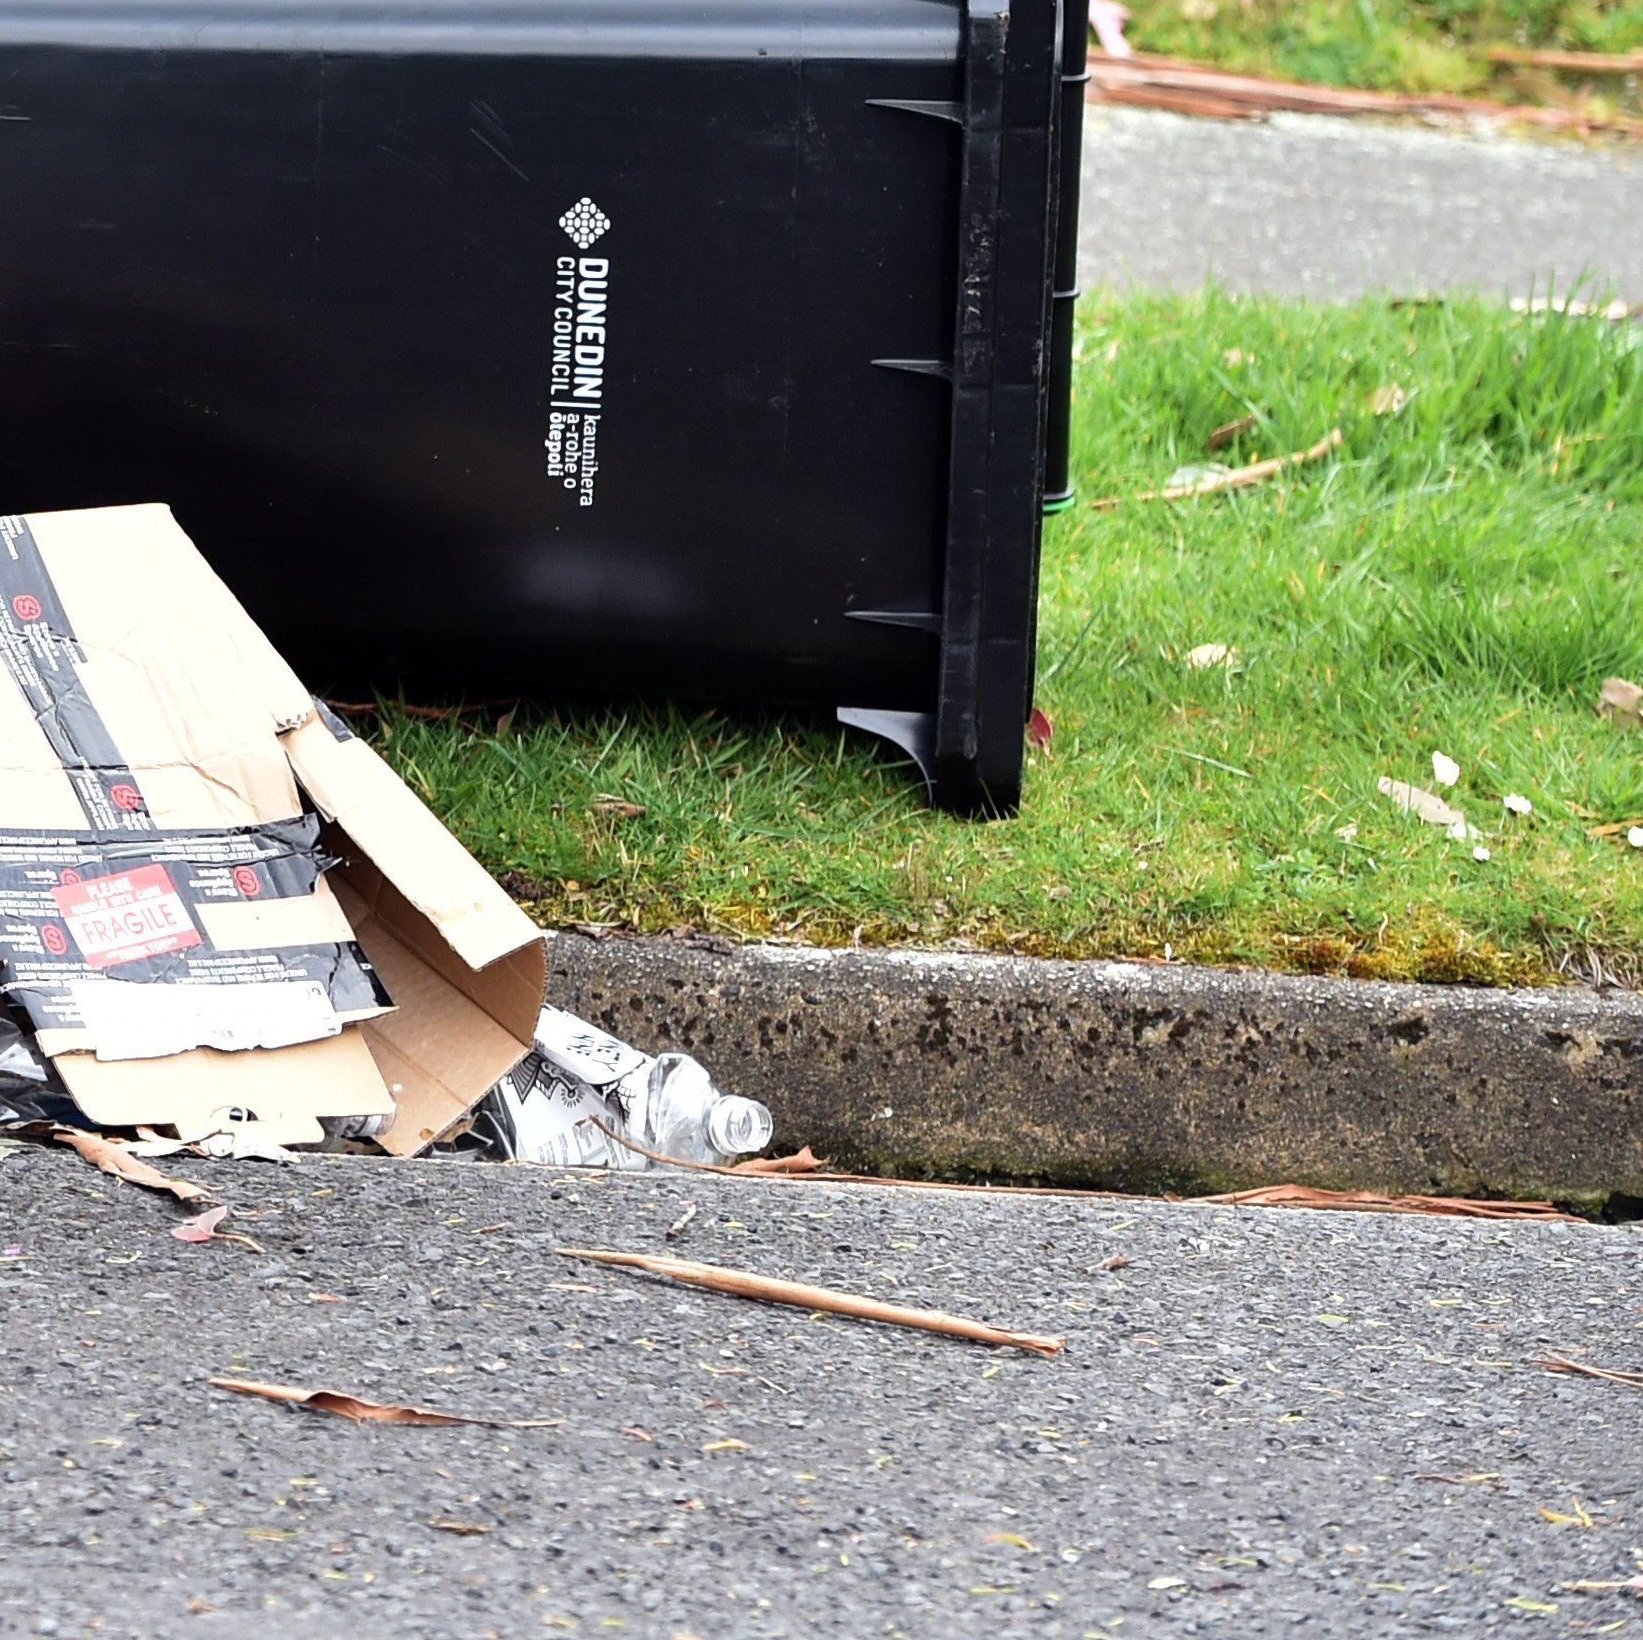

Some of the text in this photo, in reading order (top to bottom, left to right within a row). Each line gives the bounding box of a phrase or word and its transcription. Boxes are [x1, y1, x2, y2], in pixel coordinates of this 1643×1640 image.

[550, 256, 575, 396] CITY COUNCIL
[572, 258, 609, 398] DUNEDIN
[564, 412, 582, 489] a-rohe o
[580, 413, 601, 507] kaunihera
[80, 902, 178, 945] FRAGILE
[84, 876, 134, 900] PLEASE
